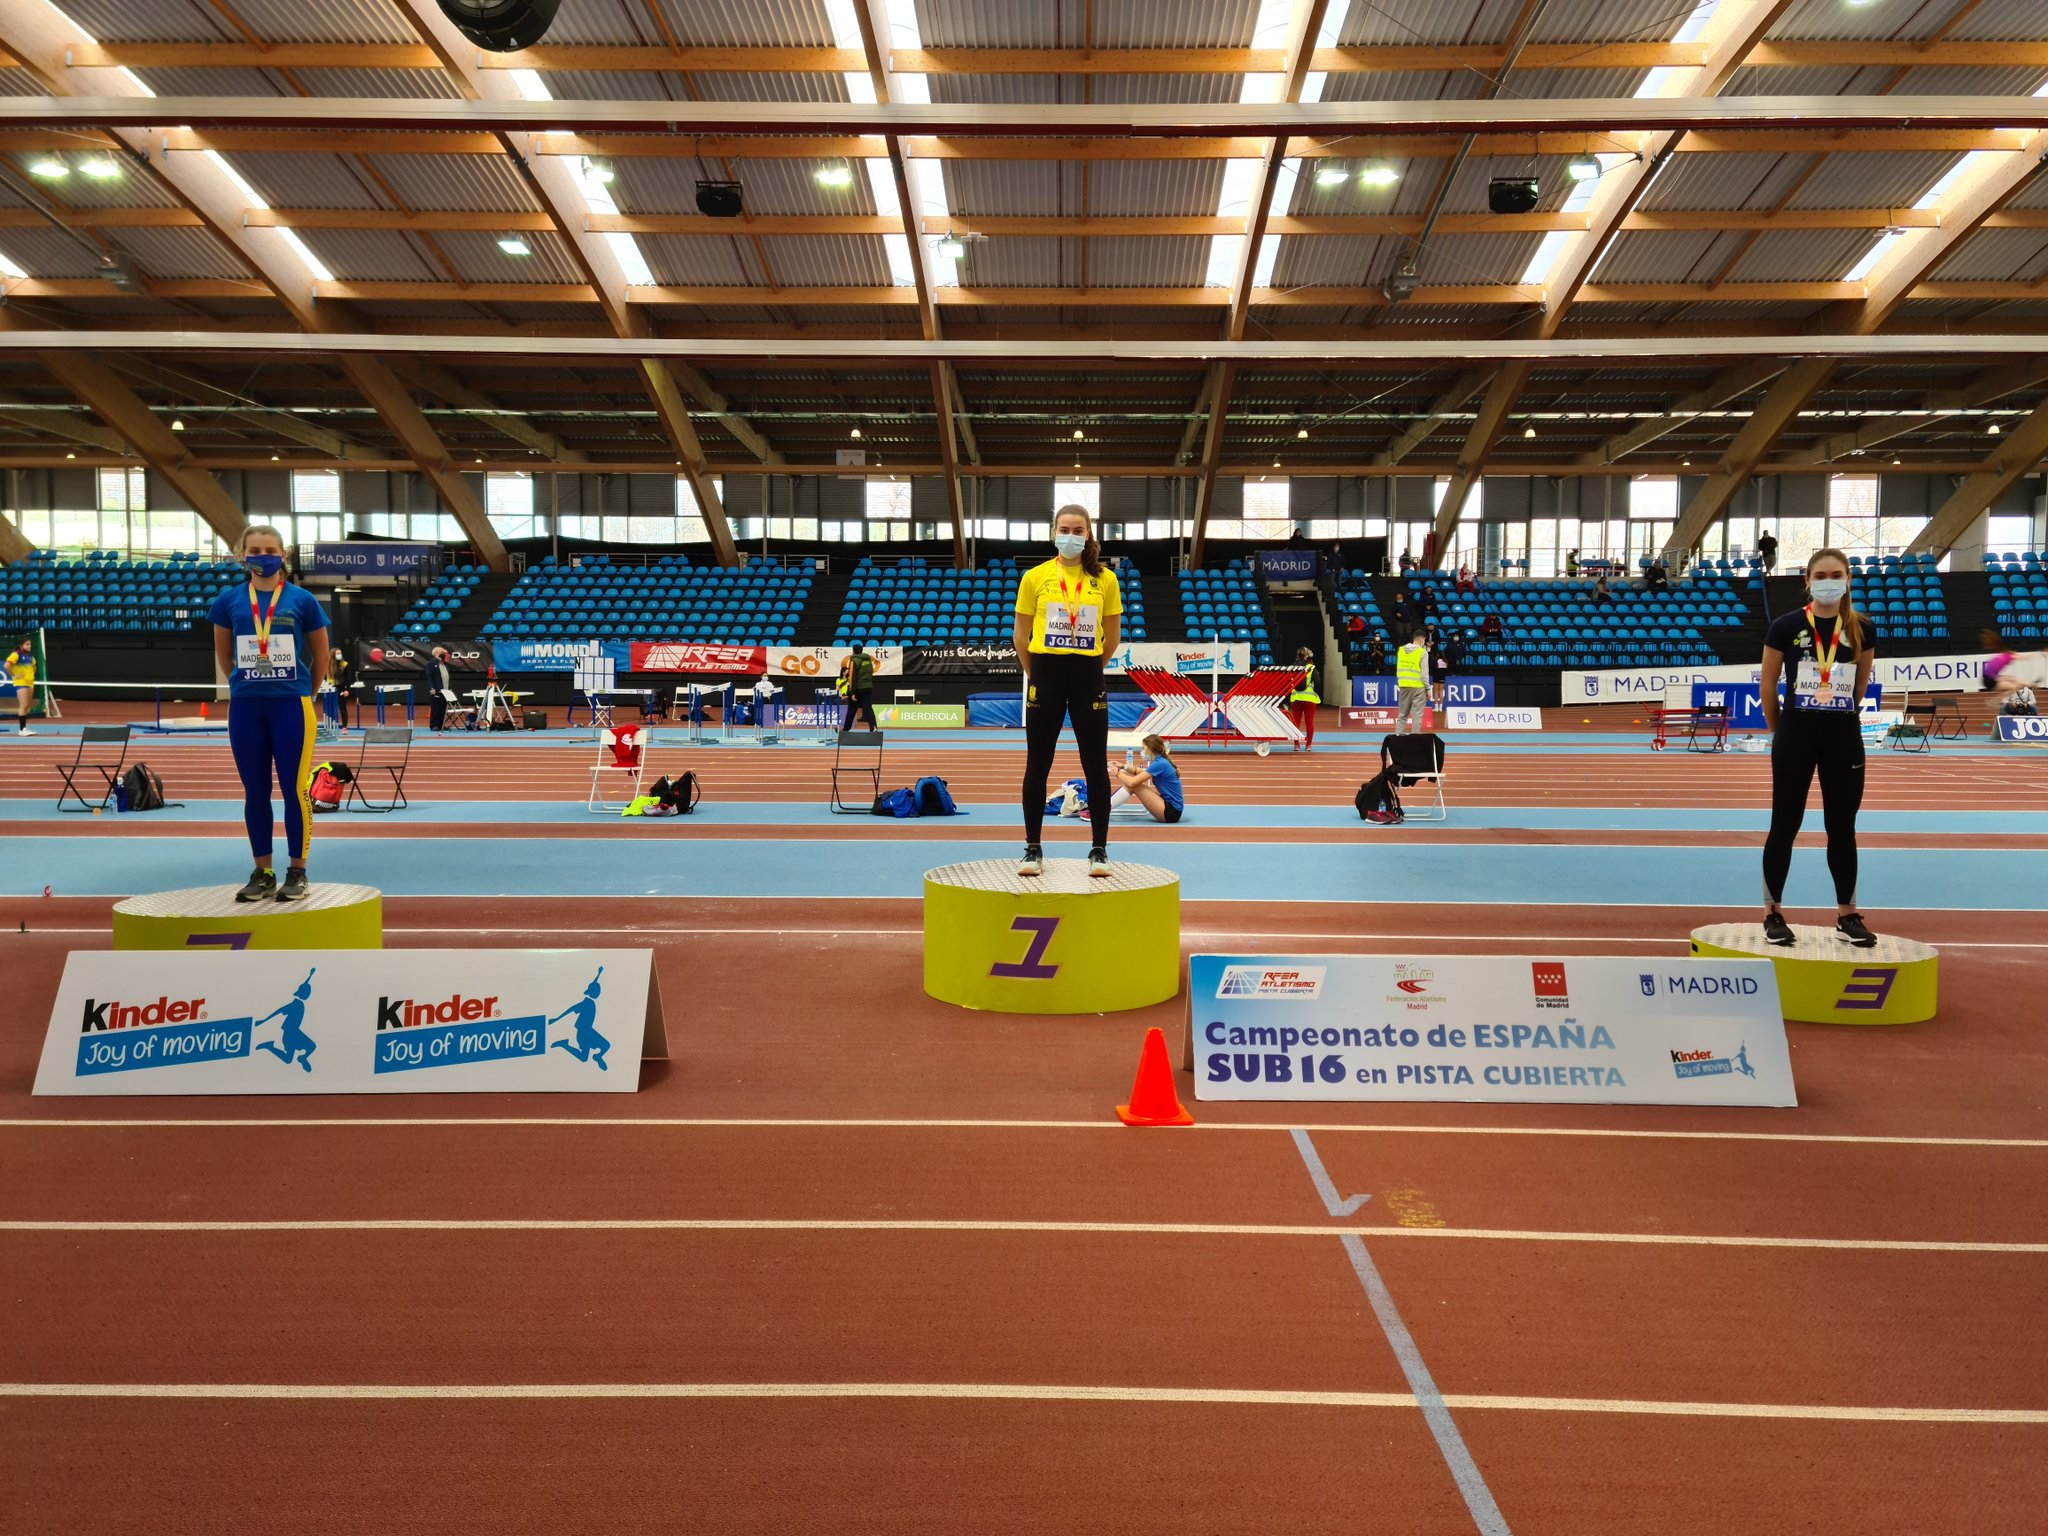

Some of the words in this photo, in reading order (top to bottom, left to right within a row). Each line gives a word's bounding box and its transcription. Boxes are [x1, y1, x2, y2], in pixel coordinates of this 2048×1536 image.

[316, 554, 367, 565] MADRID
[1262, 560, 1311, 571] MADRID
[1078, 623, 1094, 633] 2020
[385, 650, 415, 658] DJO
[451, 651, 480, 659] DJO
[534, 643, 603, 658] MOND
[875, 648, 889, 659] fit
[922, 650, 955, 658] VIAJES
[273, 653, 292, 662] 2020
[781, 654, 821, 676] GO
[815, 647, 829, 659] fit
[1176, 652, 1205, 662] Kinder
[680, 662, 749, 671] ATLETISMO
[1835, 683, 1852, 692] 2020
[901, 711, 959, 721] IBERDROLA
[1475, 712, 1533, 723] MADRID
[989, 916, 1061, 979] 1
[1668, 976, 1758, 995] MADRID
[1835, 967, 1899, 1011] 3
[1406, 1002, 1428, 1010] Madrid
[81, 996, 206, 1033] Kinder
[376, 994, 499, 1031] Kinder
[1205, 1021, 1420, 1053] Campeonato
[1427, 1023, 1467, 1048] de
[1474, 1017, 1617, 1049] ESPAÑA
[84, 1041, 126, 1067] Joy
[133, 1034, 158, 1060] of
[162, 1028, 243, 1057] moving
[382, 1039, 423, 1065] Joy
[429, 1032, 454, 1057] of
[459, 1026, 537, 1054] moving
[1670, 1049, 1712, 1063] Kinder
[1678, 1066, 1693, 1076] Joy
[1693, 1065, 1700, 1074] of
[1702, 1062, 1730, 1073] moving
[1356, 1067, 1387, 1085] en
[1396, 1064, 1475, 1085] PISTA
[1483, 1065, 1627, 1087] CUBIERTA
